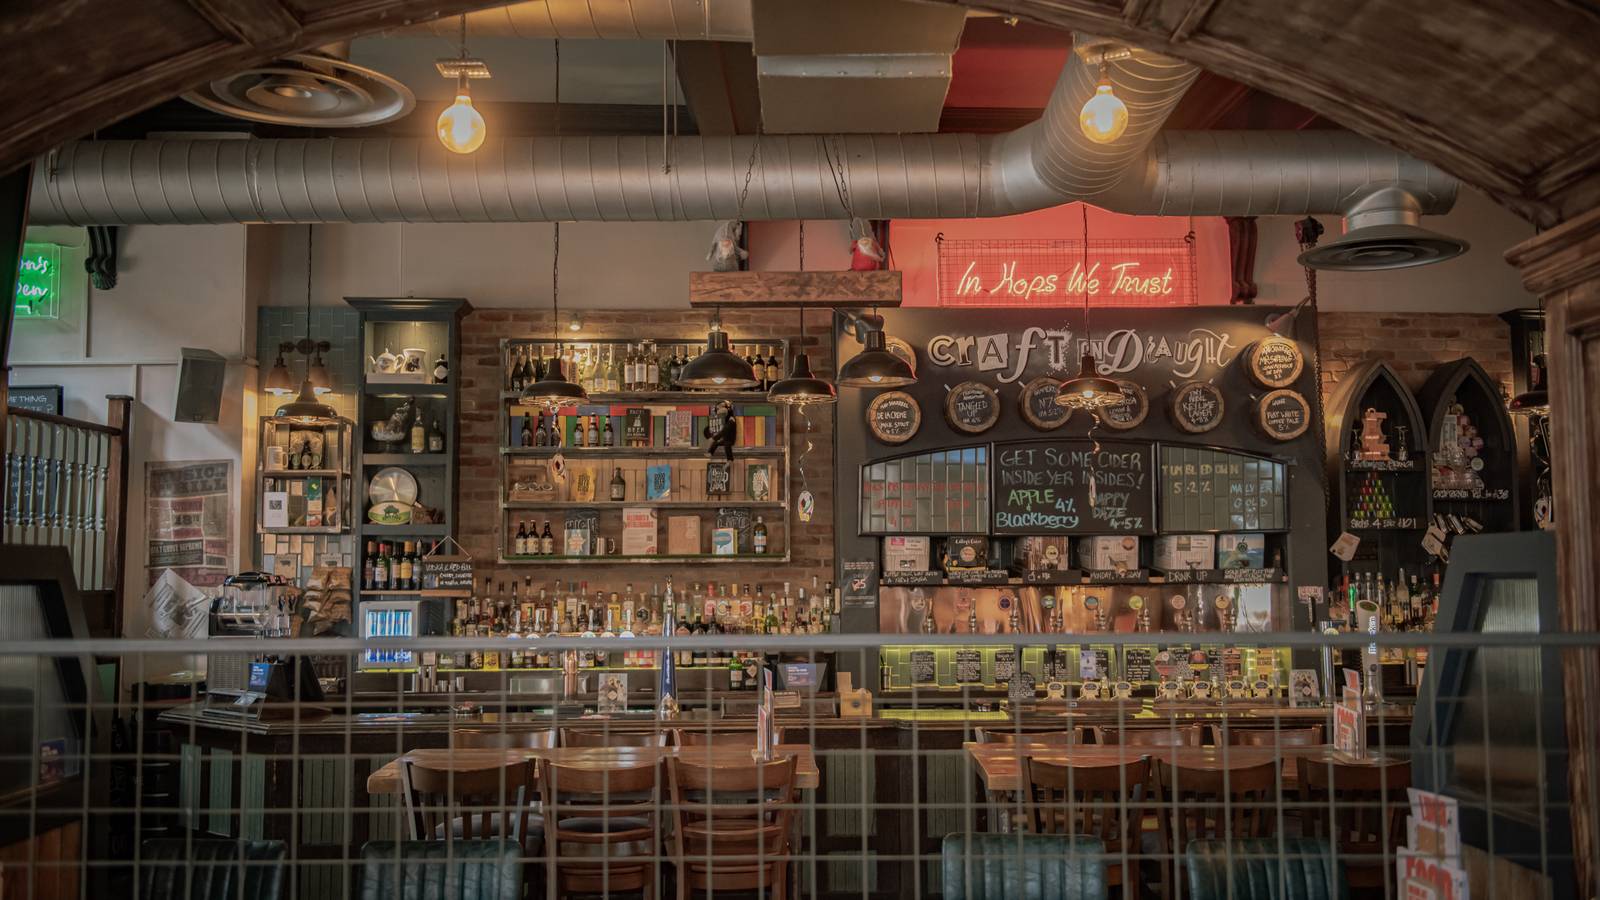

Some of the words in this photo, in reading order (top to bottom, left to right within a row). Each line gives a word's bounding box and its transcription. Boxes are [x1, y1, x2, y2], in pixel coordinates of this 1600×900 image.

[956, 260, 983, 297] In
[990, 261, 1059, 299] Hops
[1067, 262, 1101, 296] We
[1111, 262, 1173, 296] Trust
[1000, 449, 1038, 466] GET
[1044, 448, 1092, 467] SOME
[1098, 451, 1141, 471] CIDER
[1002, 470, 1043, 486] INSIDE
[1046, 470, 1074, 486] YER
[1082, 470, 1144, 489] INSIDES!
[1007, 489, 1055, 507] APPLE
[1055, 498, 1076, 513] 4%
[996, 512, 1079, 528] Blackberry
[1168, 571, 1191, 582] DRINK
[1196, 571, 1209, 581] UP
